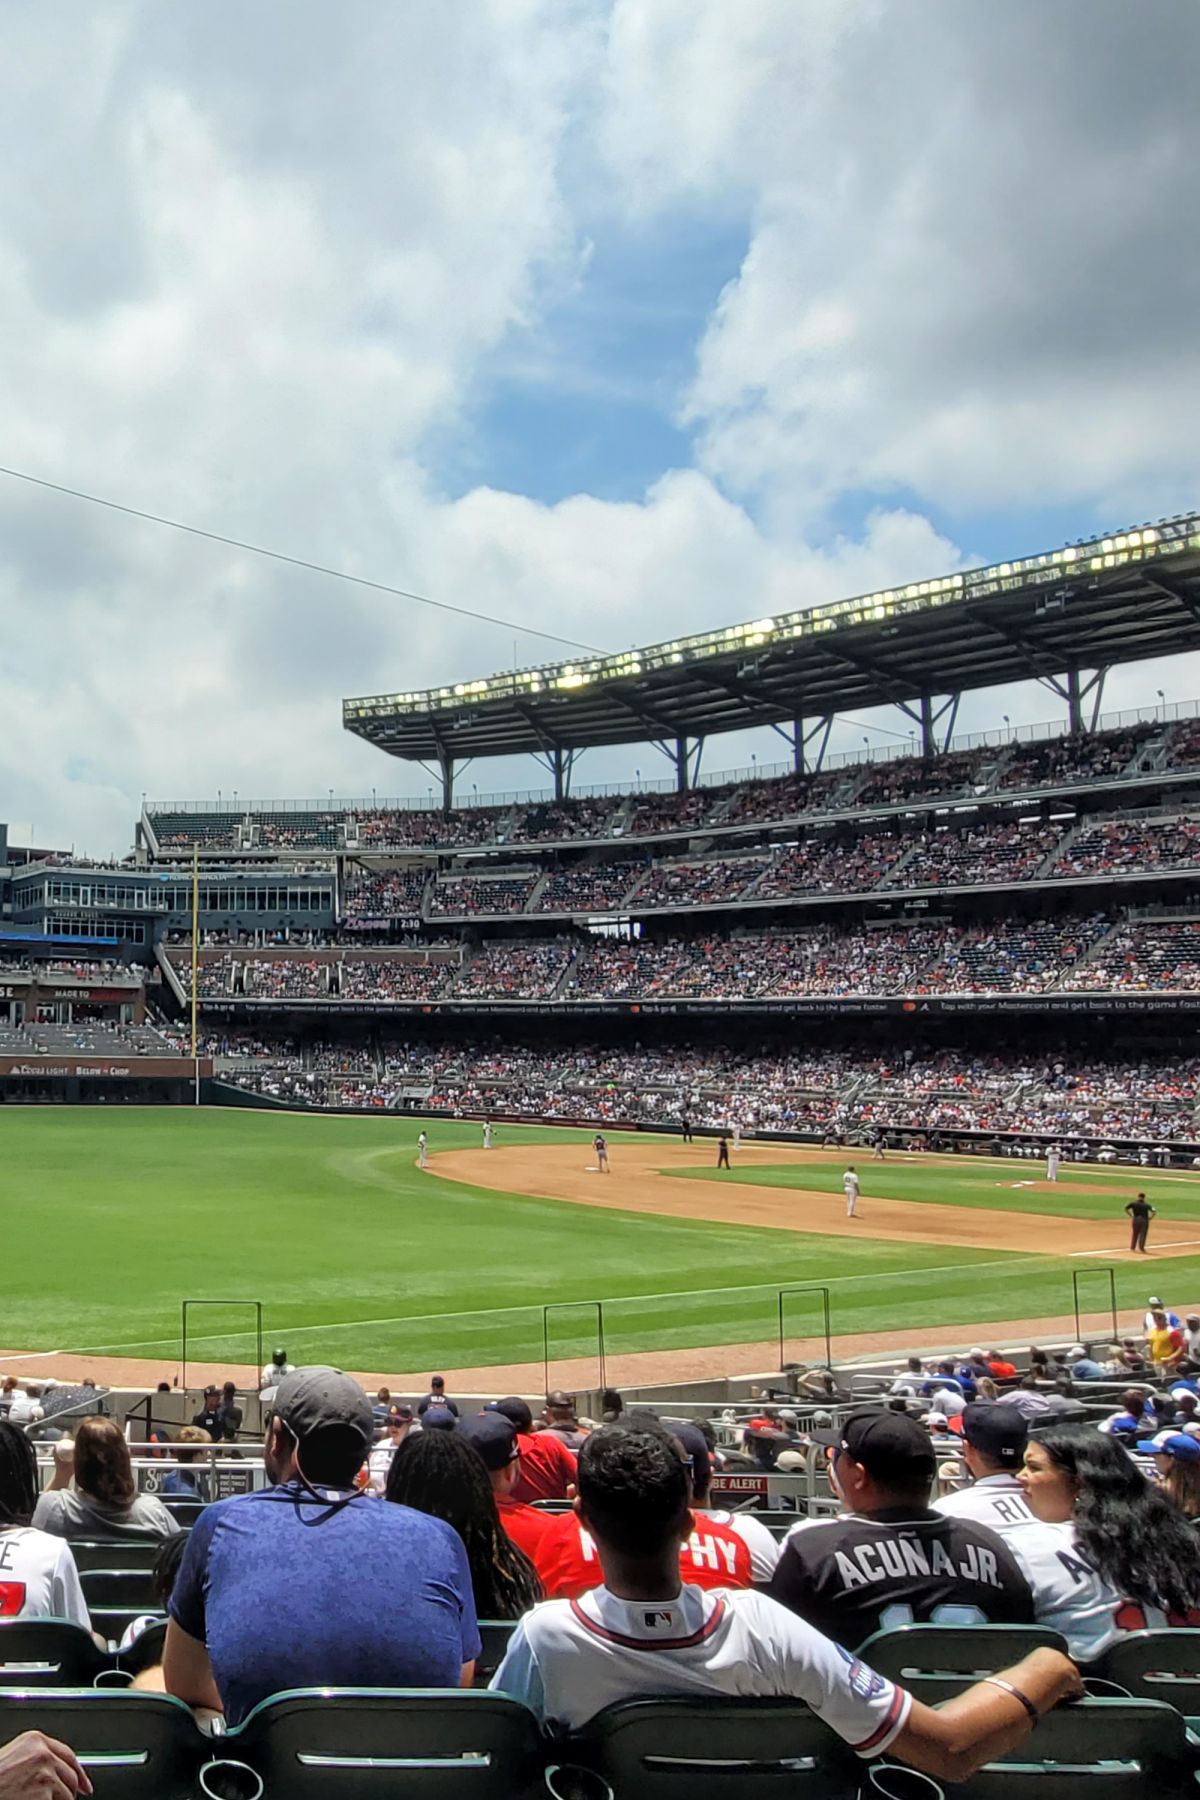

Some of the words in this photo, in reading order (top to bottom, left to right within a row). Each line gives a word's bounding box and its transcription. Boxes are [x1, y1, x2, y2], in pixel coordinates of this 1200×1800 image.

[713, 1478, 727, 1489] BE
[729, 1478, 762, 1489] ALERT
[834, 1530, 958, 1589] ACUÑA
[959, 1543, 1004, 1590] JR.
